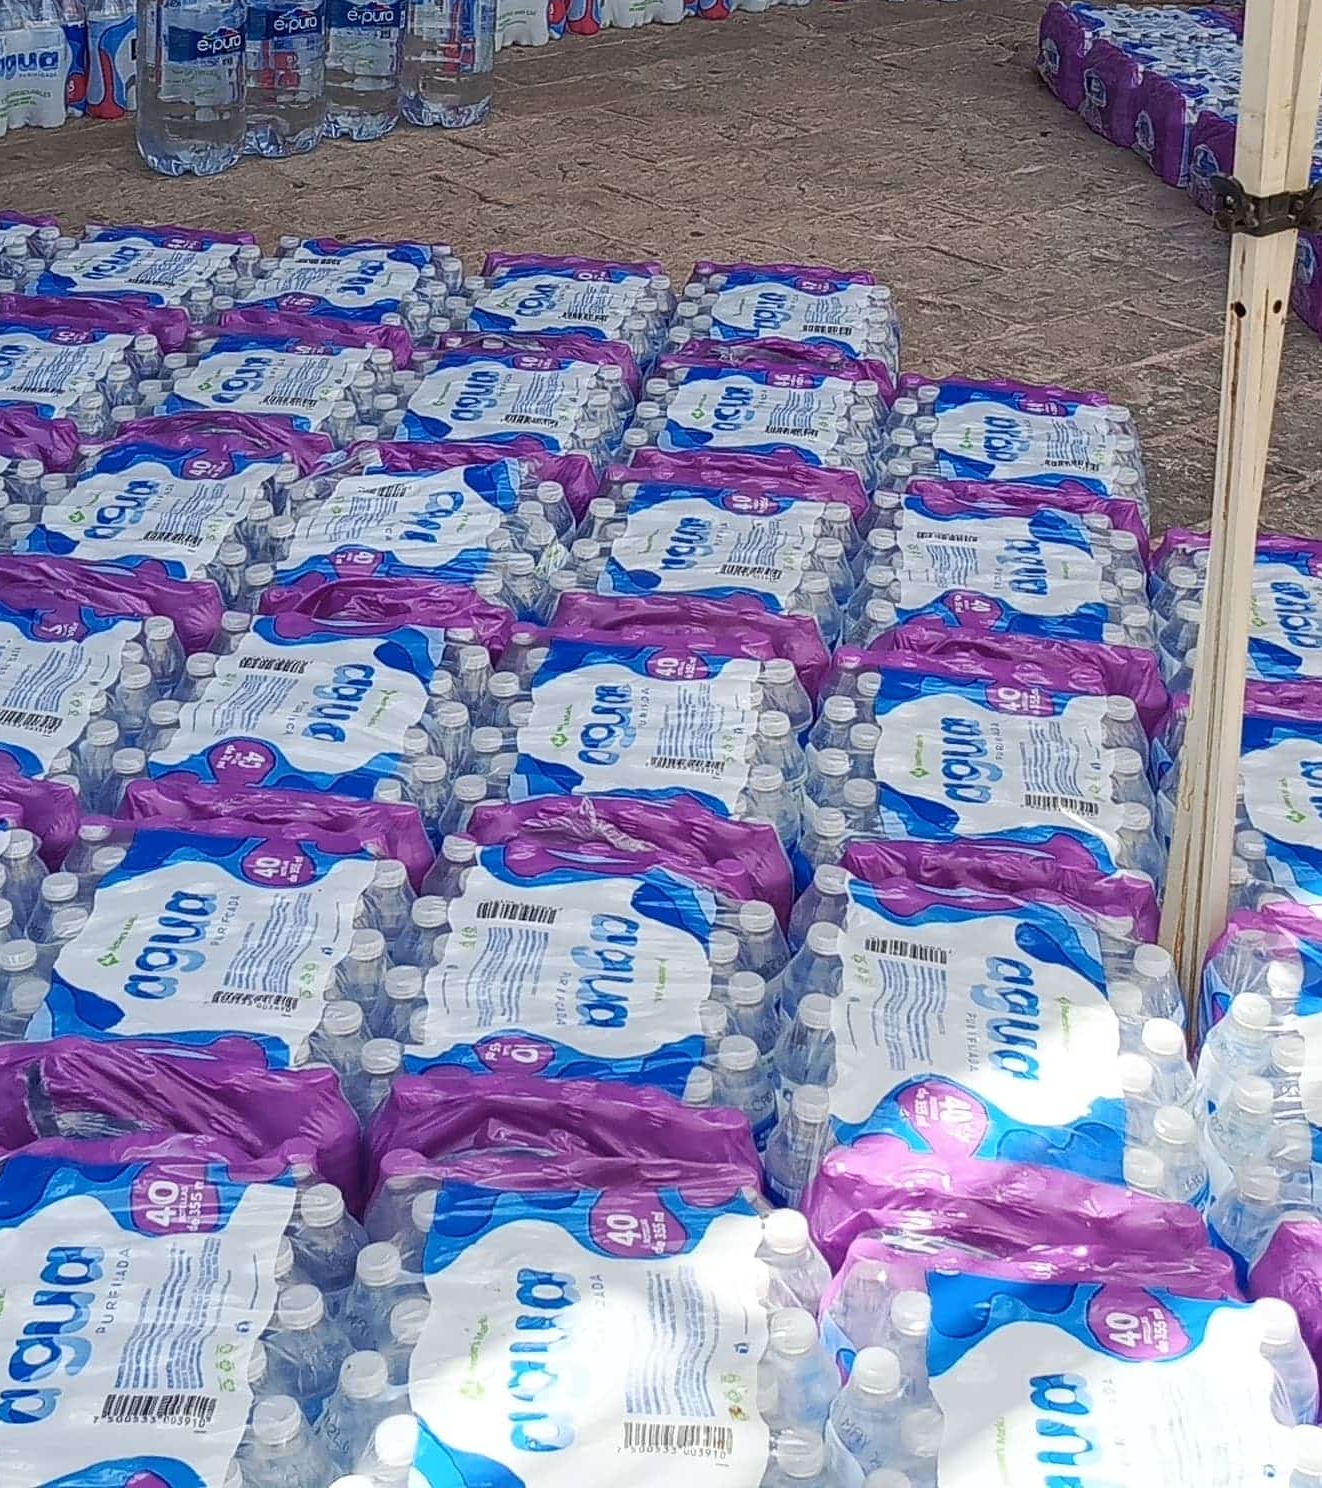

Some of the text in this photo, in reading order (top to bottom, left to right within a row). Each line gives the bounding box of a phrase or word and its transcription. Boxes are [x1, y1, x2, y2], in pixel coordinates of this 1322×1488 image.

[83, 478, 163, 542] agua
[301, 663, 377, 744] agua
[578, 683, 637, 767] agua
[994, 685, 1022, 713] 40
[939, 714, 1007, 807] agua
[123, 889, 219, 1002] agua
[570, 912, 641, 1030] agua
[971, 953, 1046, 1083] agua
[146, 1180, 179, 1228] 40
[610, 1211, 640, 1248] 40
[506, 1266, 577, 1453] agua
[1107, 1311, 1141, 1349] 40
